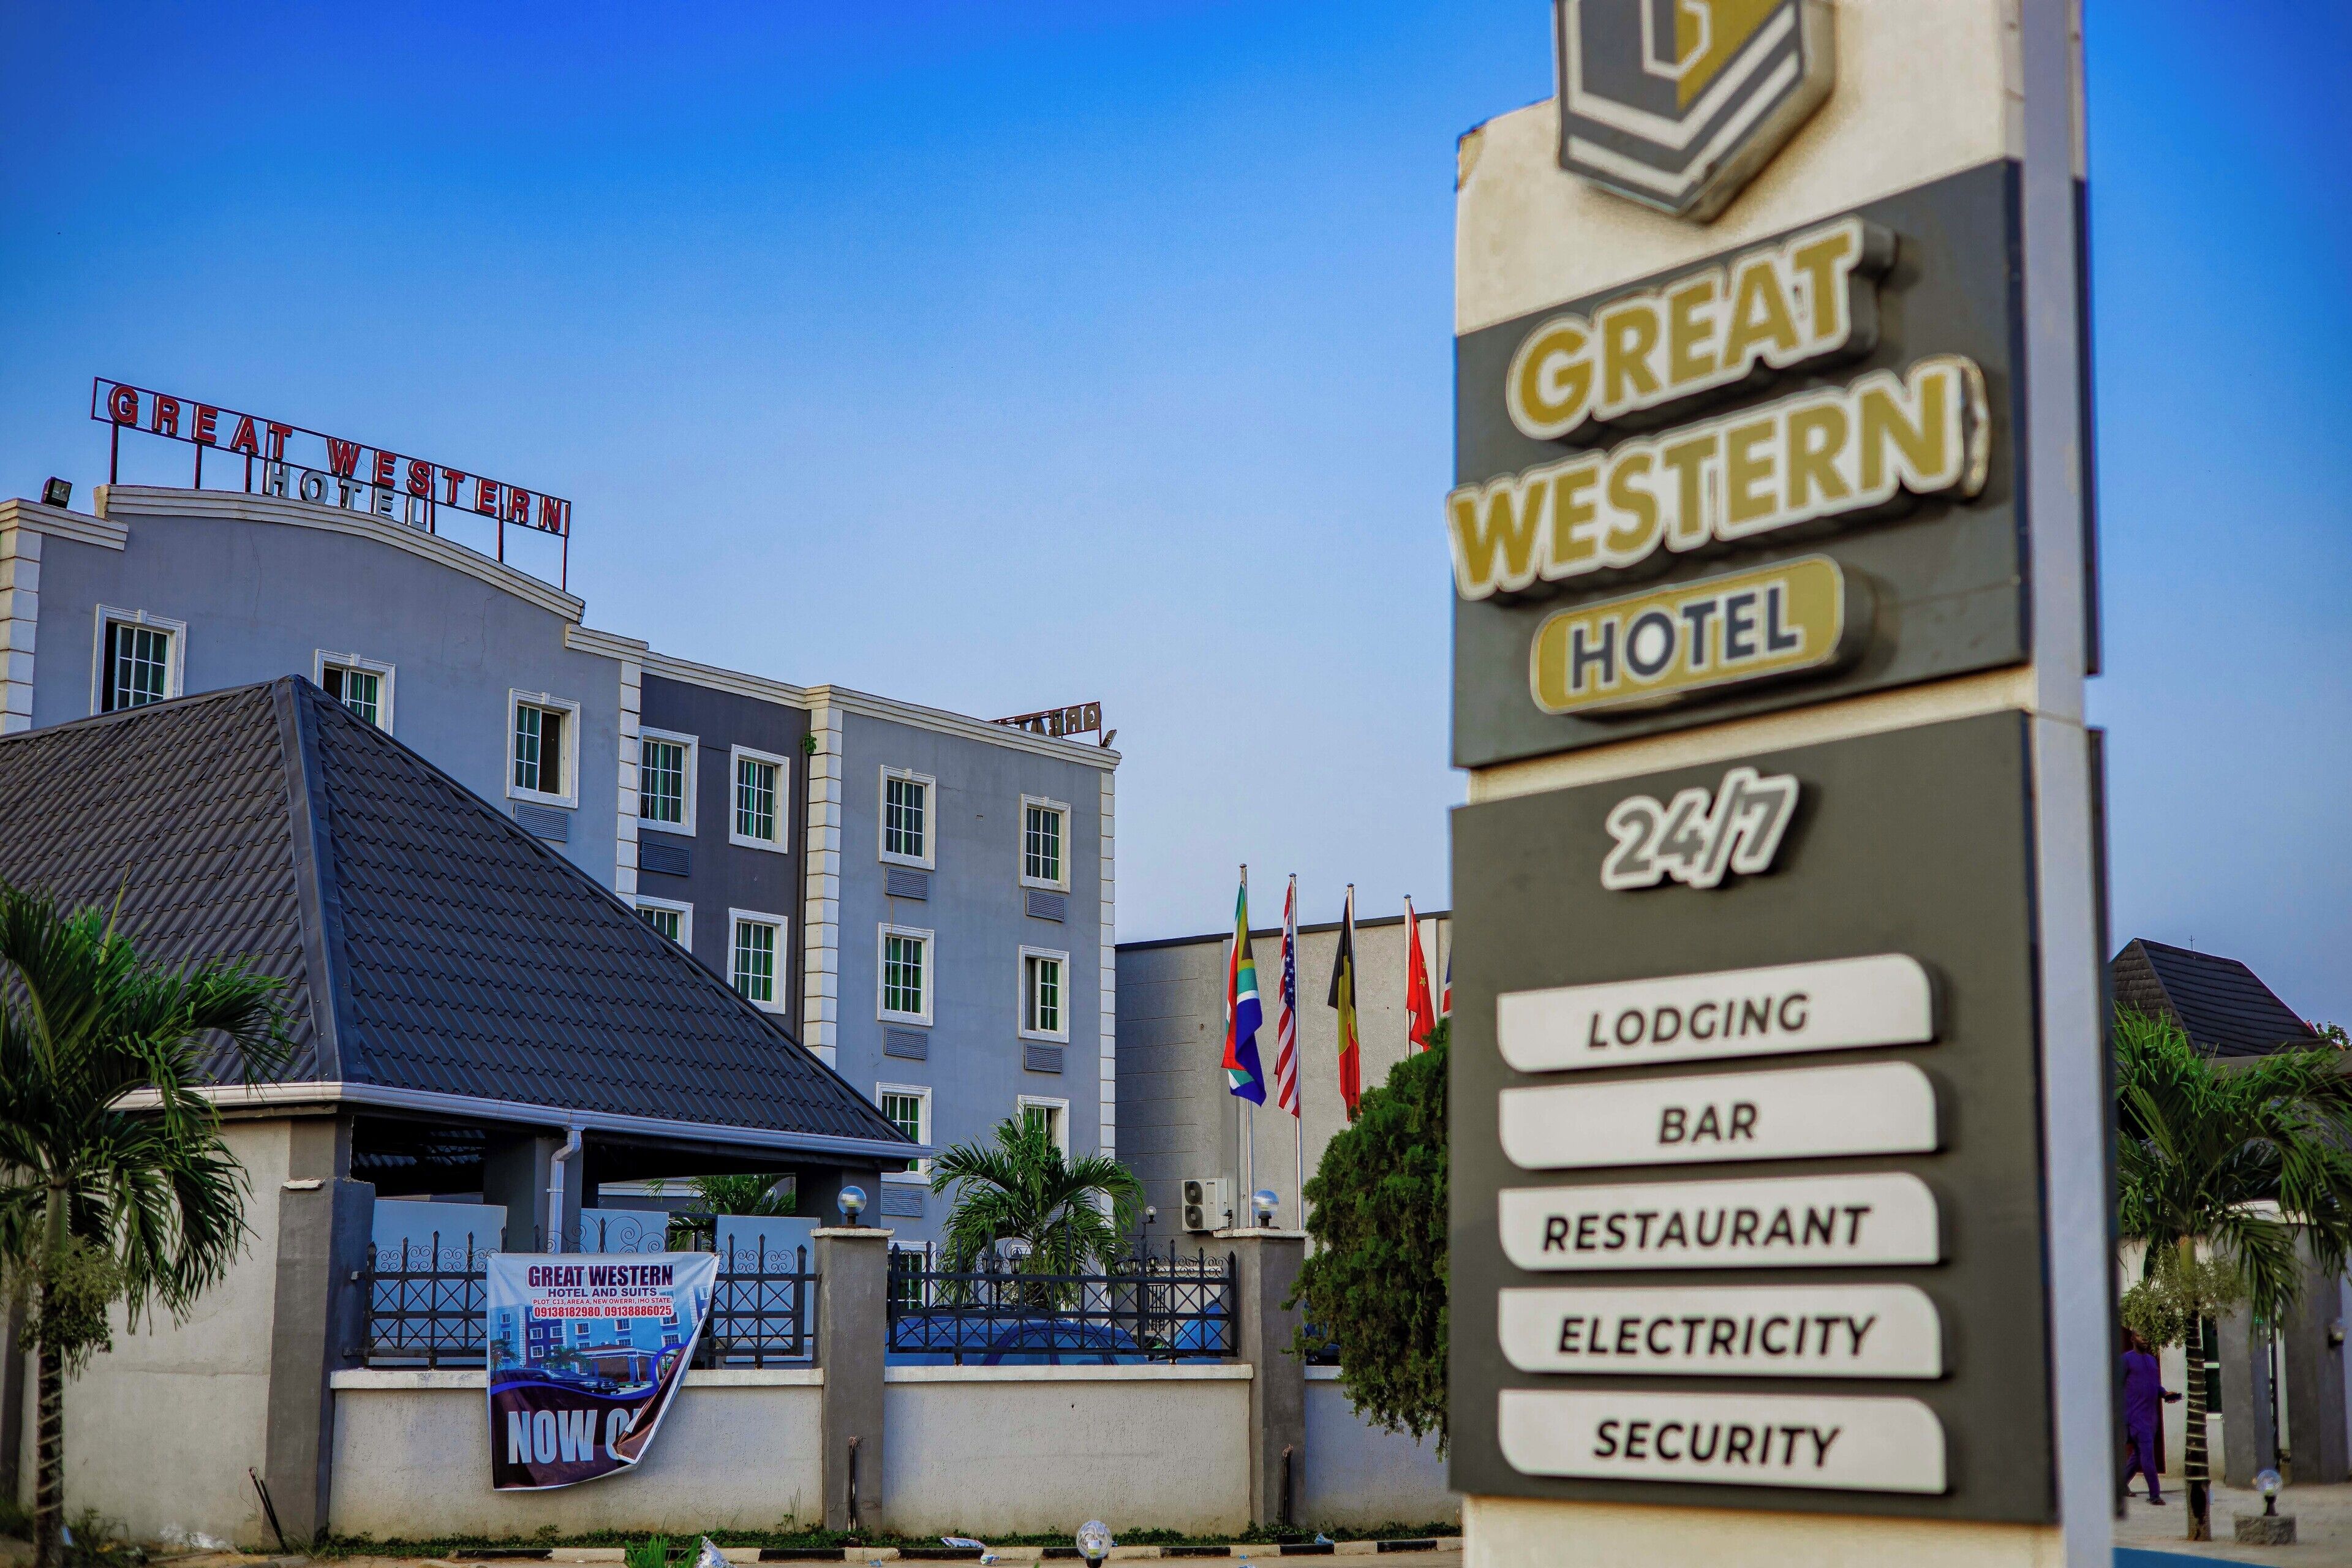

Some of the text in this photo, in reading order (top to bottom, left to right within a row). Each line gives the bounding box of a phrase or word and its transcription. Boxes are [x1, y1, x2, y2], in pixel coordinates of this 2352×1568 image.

[1513, 225, 1857, 431] GREAT
[107, 385, 562, 532] GREAT WESTERN
[1449, 369, 1953, 589] WESTERN
[262, 460, 428, 531] HOTEL
[1570, 583, 1799, 692] HOTEL
[1604, 769, 1797, 888] 24/7
[1588, 992, 1811, 1049] LODGING
[1657, 1102, 1758, 1144] BAR
[1542, 1205, 1872, 1253] RESTAURANT
[528, 1265, 673, 1287] GREAT WESTERN
[548, 1287, 657, 1297] HOTEL AND SUITS
[534, 1305, 672, 1317] 09138182980, 09138886025
[1556, 1315, 1878, 1357] ELECTRICITY
[508, 1409, 598, 1464] NOW
[1593, 1419, 1842, 1468] SECURITY
